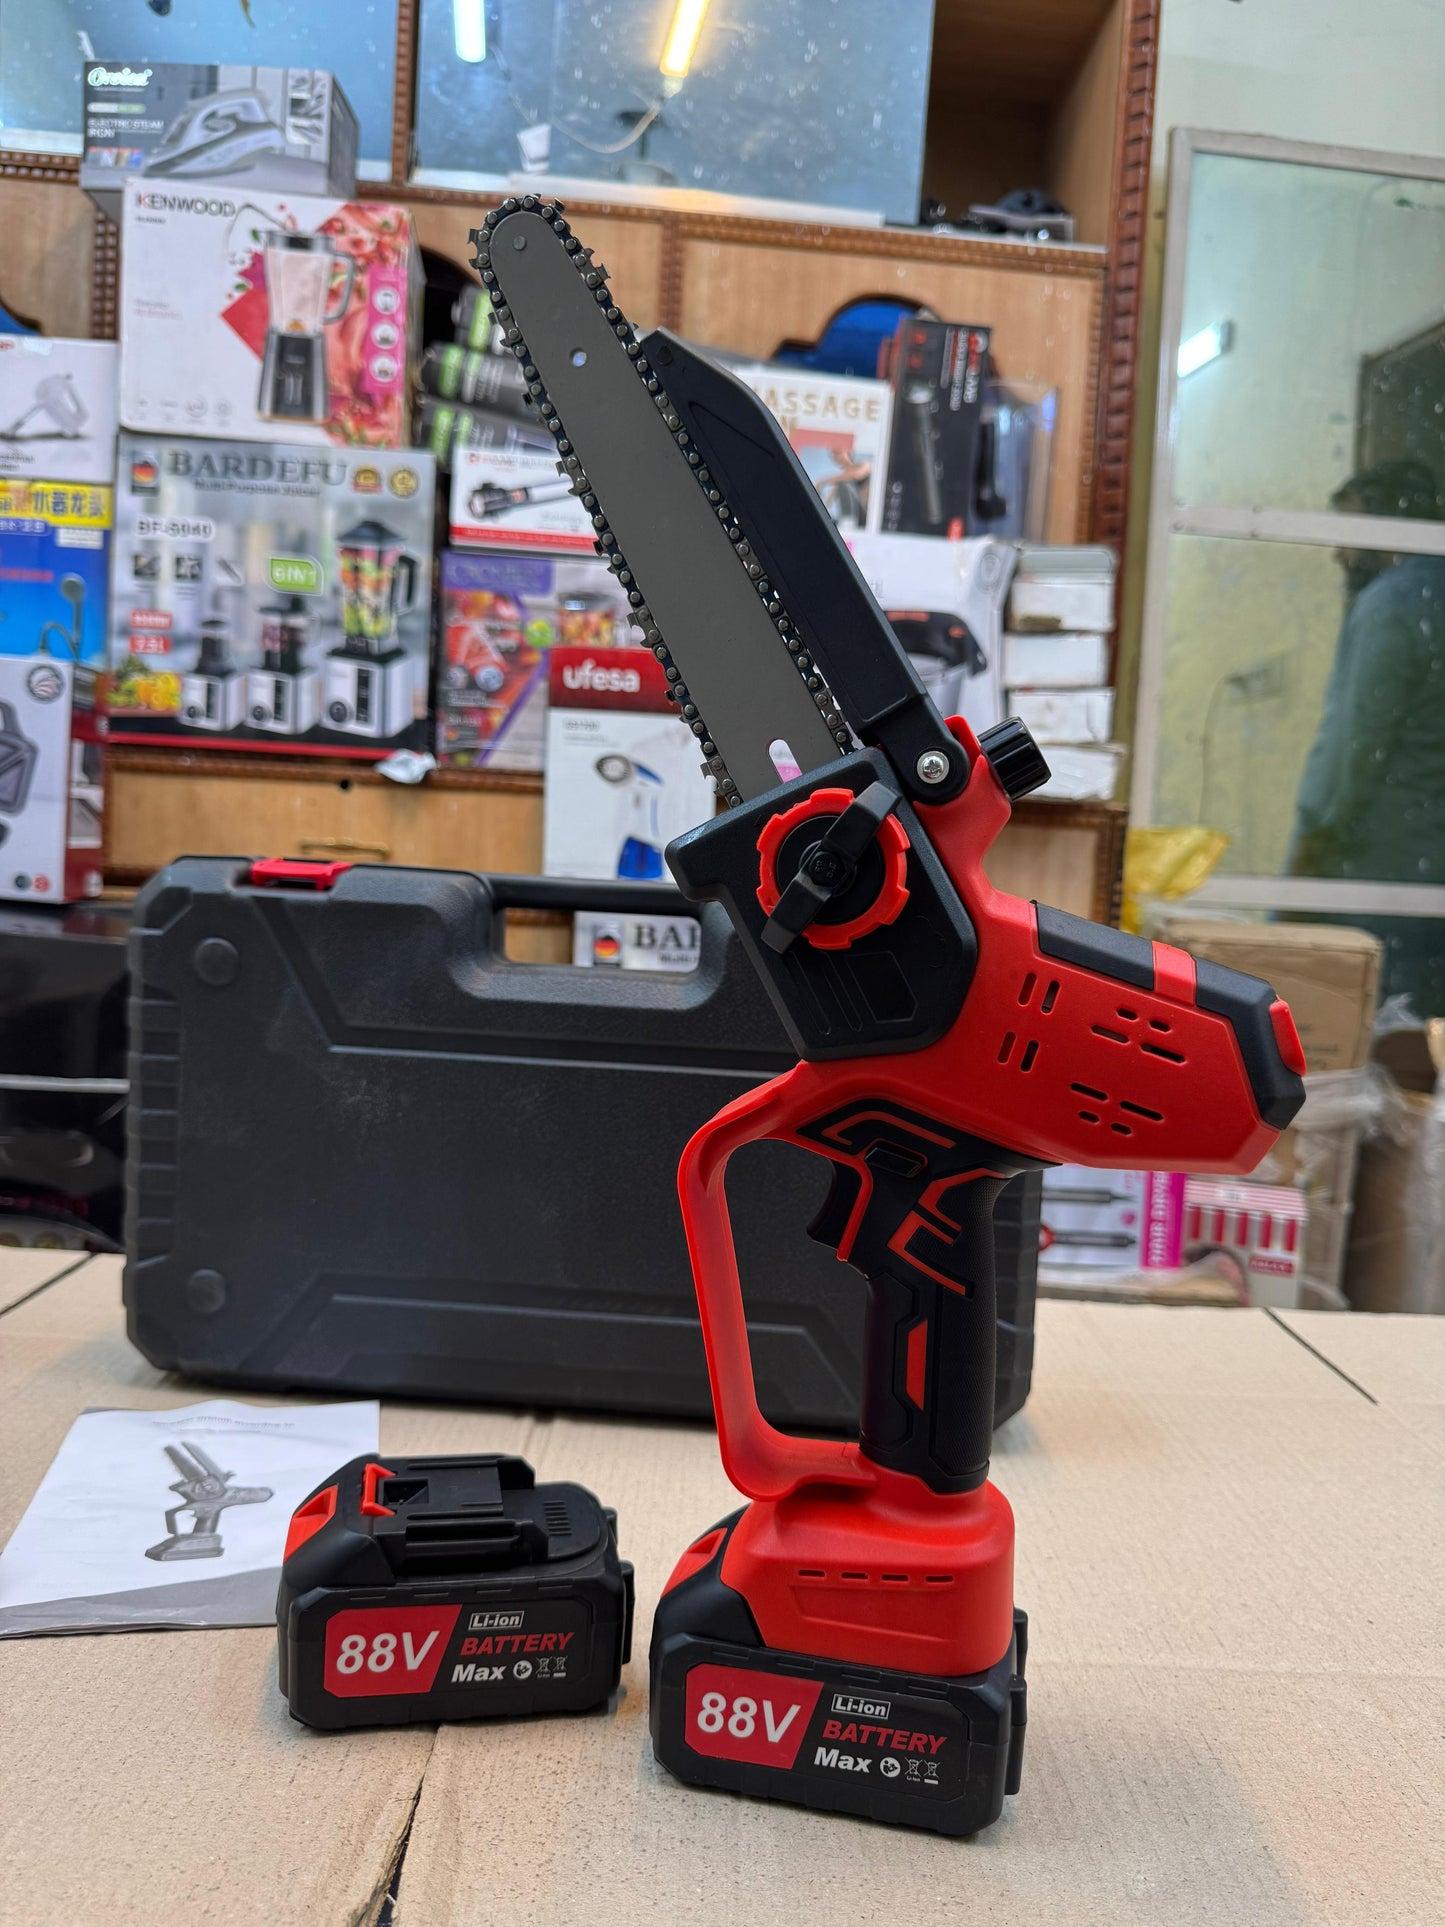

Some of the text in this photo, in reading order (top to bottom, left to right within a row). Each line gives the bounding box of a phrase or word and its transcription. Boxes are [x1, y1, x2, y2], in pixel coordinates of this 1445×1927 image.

[135, 193, 236, 217] KENWOOD
[752, 385, 881, 422] ASSAGE
[168, 448, 348, 486] BARDEFU
[563, 658, 641, 693] ufesa
[472, 1612, 520, 1628] Li-ion
[336, 1630, 441, 1675] 88V
[460, 1632, 575, 1656] BATTERY
[451, 1663, 507, 1684] Max
[697, 1691, 802, 1743] 88V
[834, 1696, 887, 1717] Li-ion
[822, 1719, 948, 1755] BATTERY
[814, 1746, 873, 1774] Max
